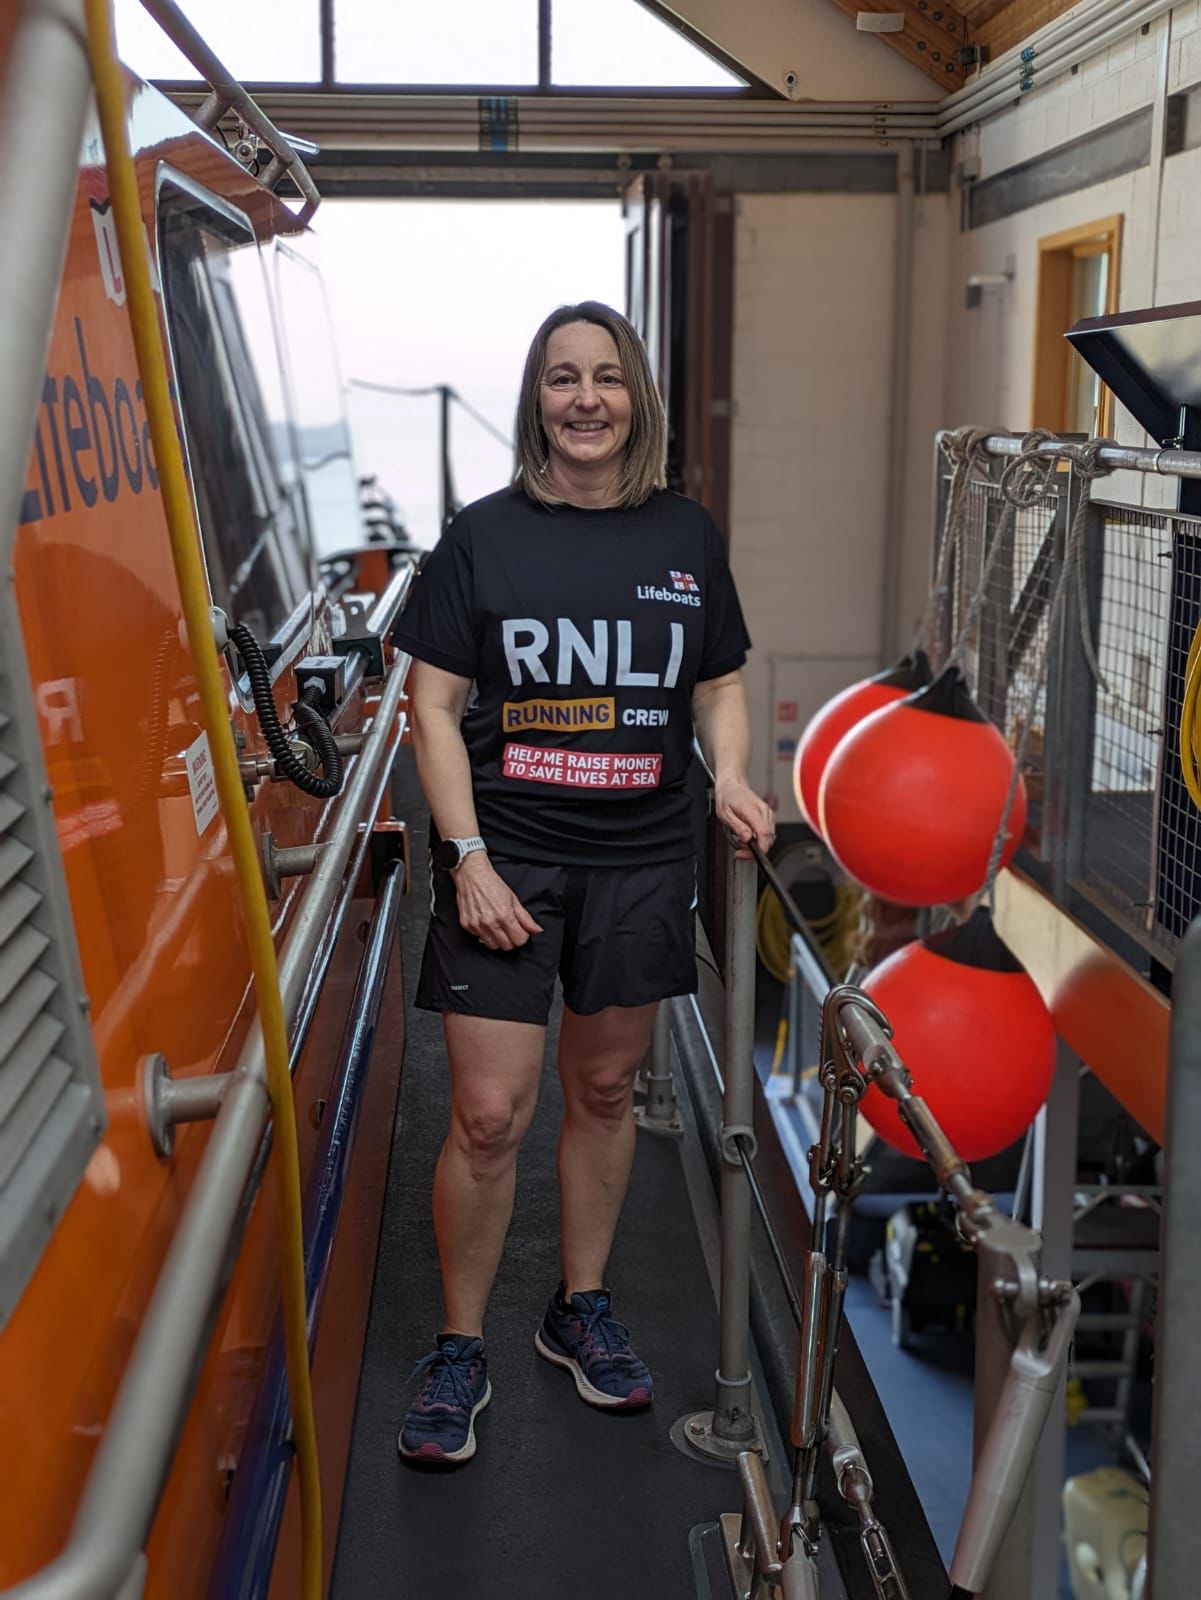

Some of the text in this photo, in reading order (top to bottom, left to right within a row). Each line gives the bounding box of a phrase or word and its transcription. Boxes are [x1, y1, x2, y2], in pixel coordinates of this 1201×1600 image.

[637, 585, 701, 607] Lifeboats
[502, 618, 684, 688] RNLI
[507, 703, 669, 727] RUNNING CREW
[508, 746, 659, 770] HELP ME RAISE MONEY
[509, 761, 656, 785] TO SAVE LIVES AT SEA
